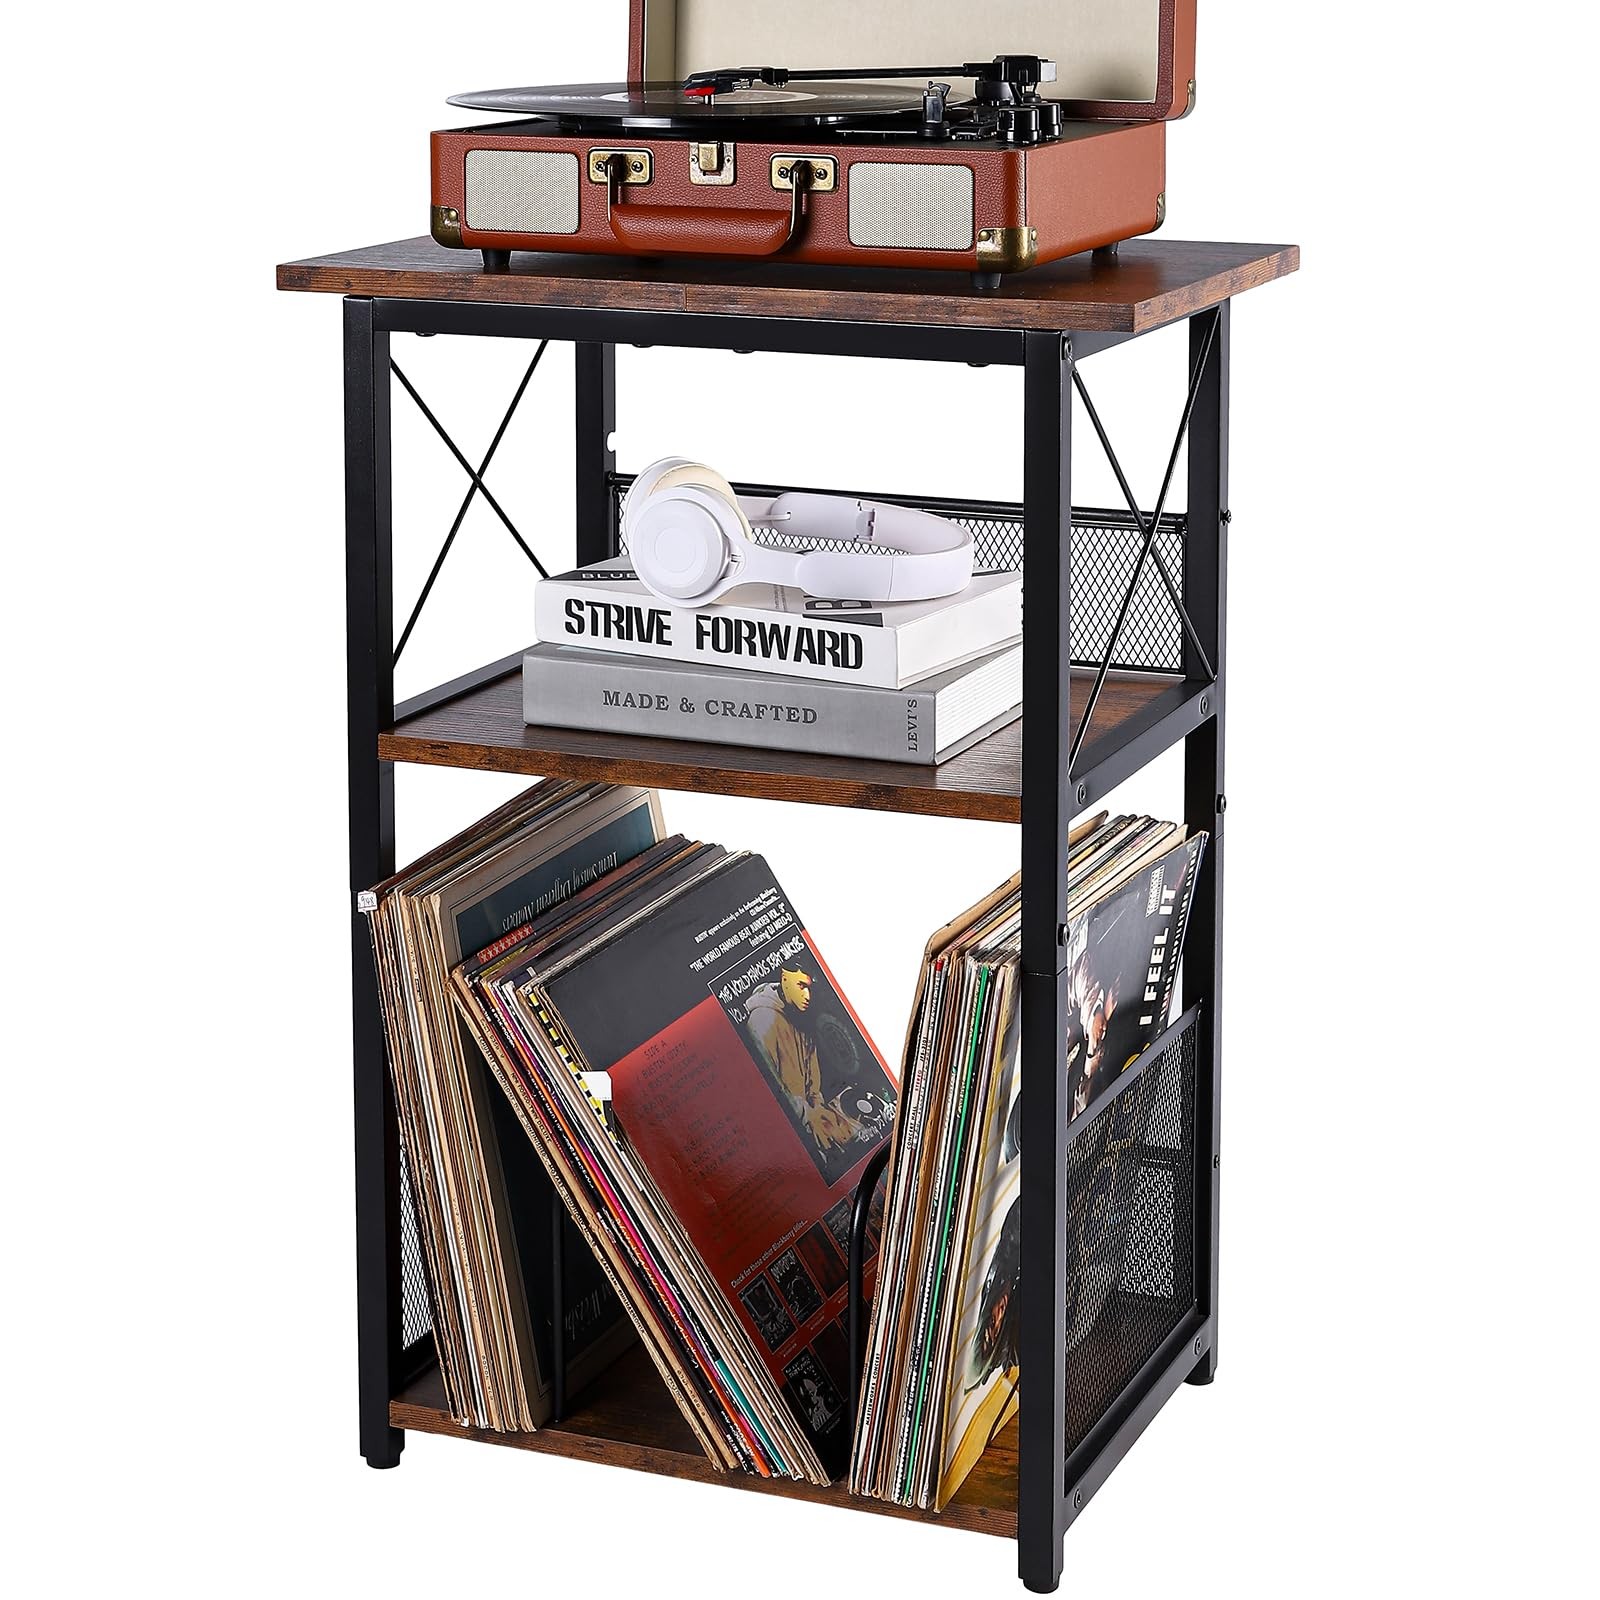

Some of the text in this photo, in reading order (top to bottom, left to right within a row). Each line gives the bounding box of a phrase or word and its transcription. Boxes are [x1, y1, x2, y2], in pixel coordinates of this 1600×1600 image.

[564, 598, 864, 670] STRIVE FORWARD
[602, 690, 818, 725] MADE & CRAFTED
[906, 698, 919, 752] LEVI'S
[1158, 884, 1176, 915] IT
[701, 947, 721, 965] WORLD
[718, 934, 740, 952] FAMOUS
[737, 926, 752, 939] BEAT
[748, 914, 770, 932] JUNKIES
[767, 908, 780, 919] VOL.
[748, 912, 793, 948] featuring DJ MELO-D
[718, 988, 732, 1005] THE
[729, 974, 752, 999] WORLD
[767, 951, 784, 969] BEAT
[1143, 927, 1170, 1002] FEEL
[1139, 1015, 1153, 1026] I
[643, 1038, 668, 1059] SIDE A
[913, 1068, 922, 1092] STEREO
[909, 1105, 917, 1121] HALL
[535, 1119, 552, 1144] DELUXE
[905, 1121, 915, 1150] CONCERT
[730, 1273, 744, 1287] Check
[749, 1257, 762, 1270] these
[760, 1247, 773, 1260] other
[771, 1229, 795, 1251] Blackberry
[864, 1381, 876, 1425] MASTERWORKS
[871, 1351, 880, 1379] CONCERT
